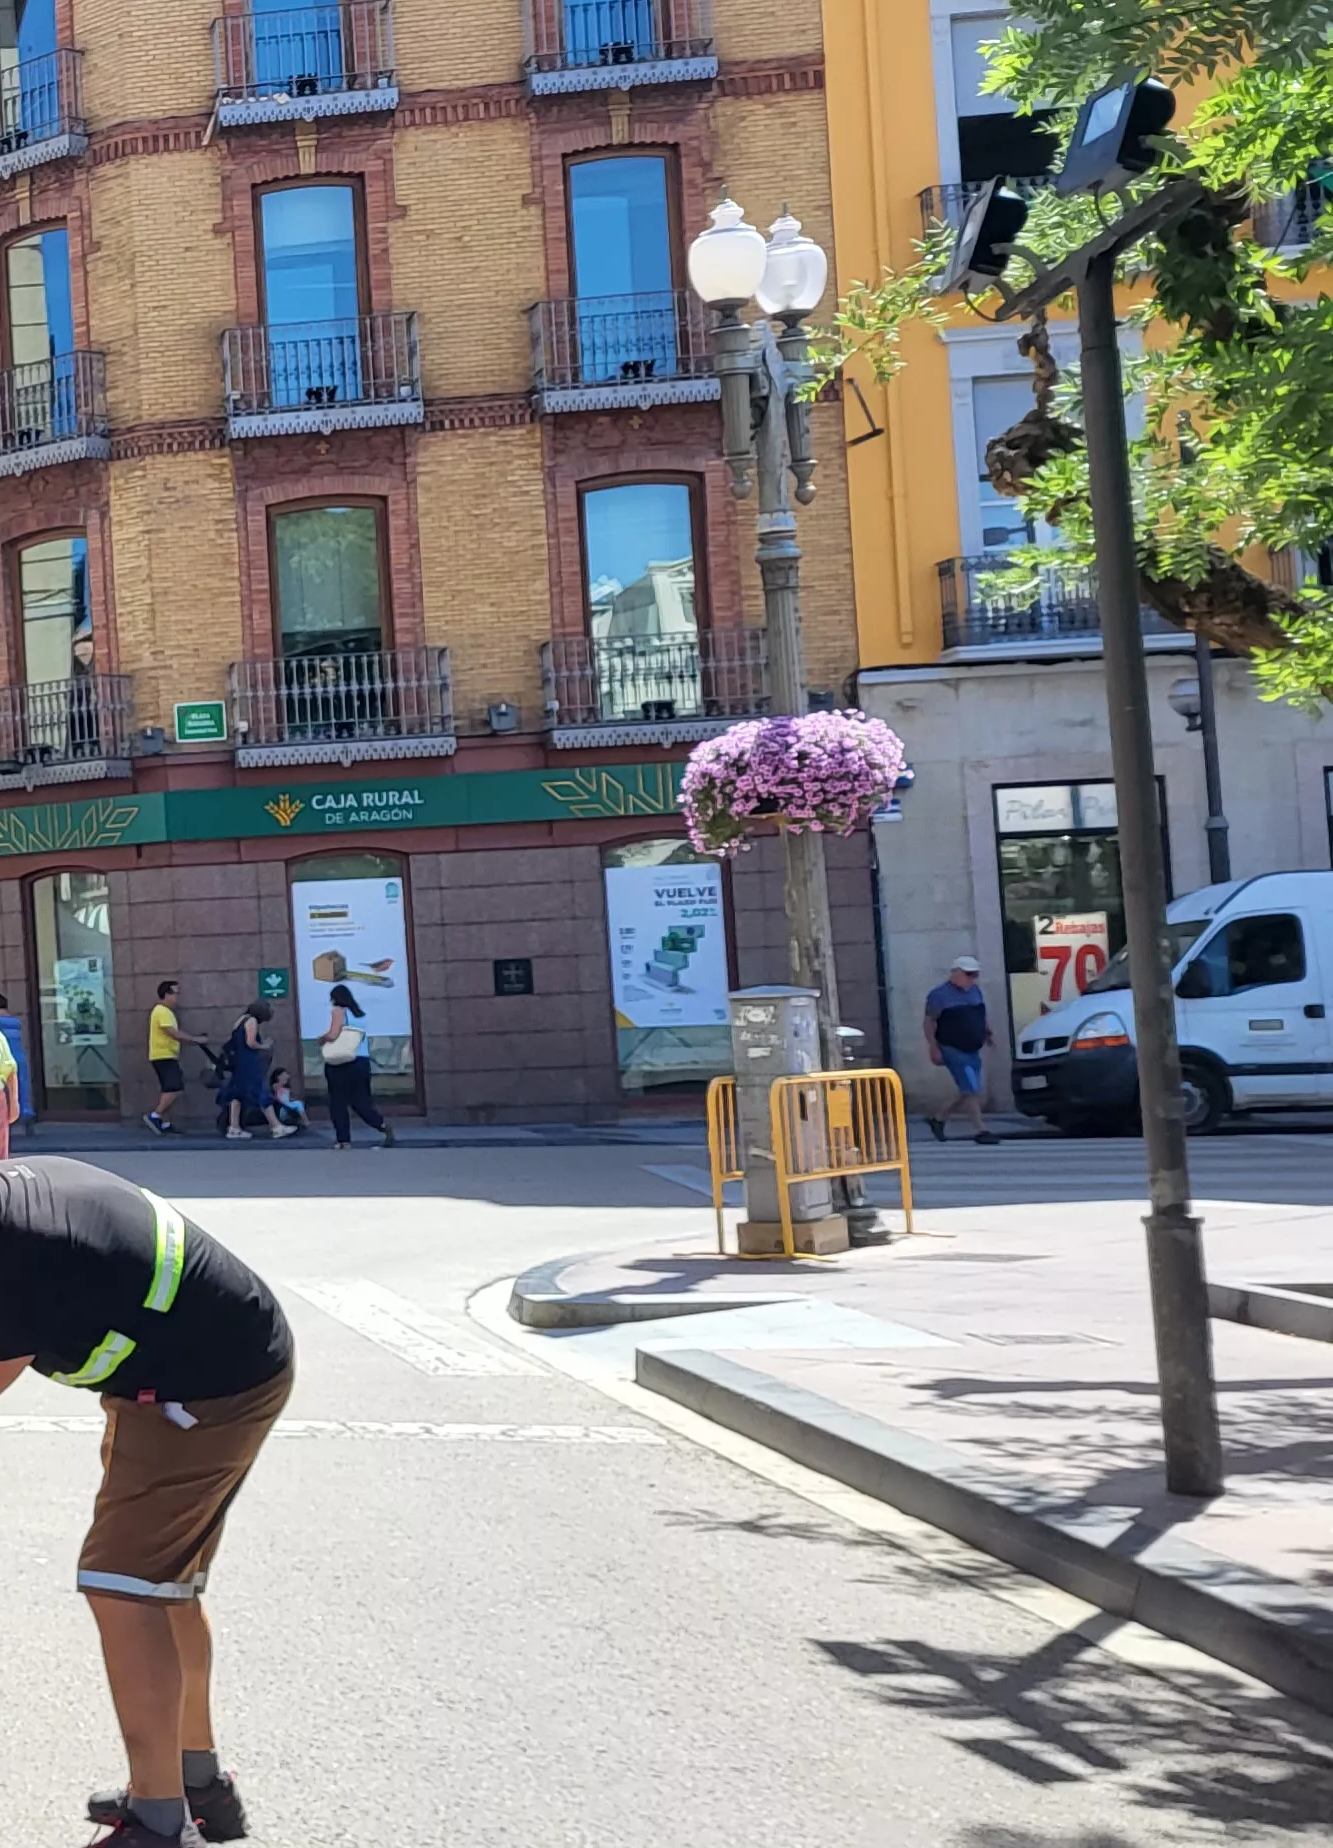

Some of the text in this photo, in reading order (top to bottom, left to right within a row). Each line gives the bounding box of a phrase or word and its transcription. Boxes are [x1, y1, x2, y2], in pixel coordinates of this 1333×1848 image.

[311, 789, 424, 810] CAJA RURAL
[325, 808, 413, 825] DE ARAGÓN
[654, 886, 717, 898] VUELVE
[1039, 944, 1106, 1002] 70
